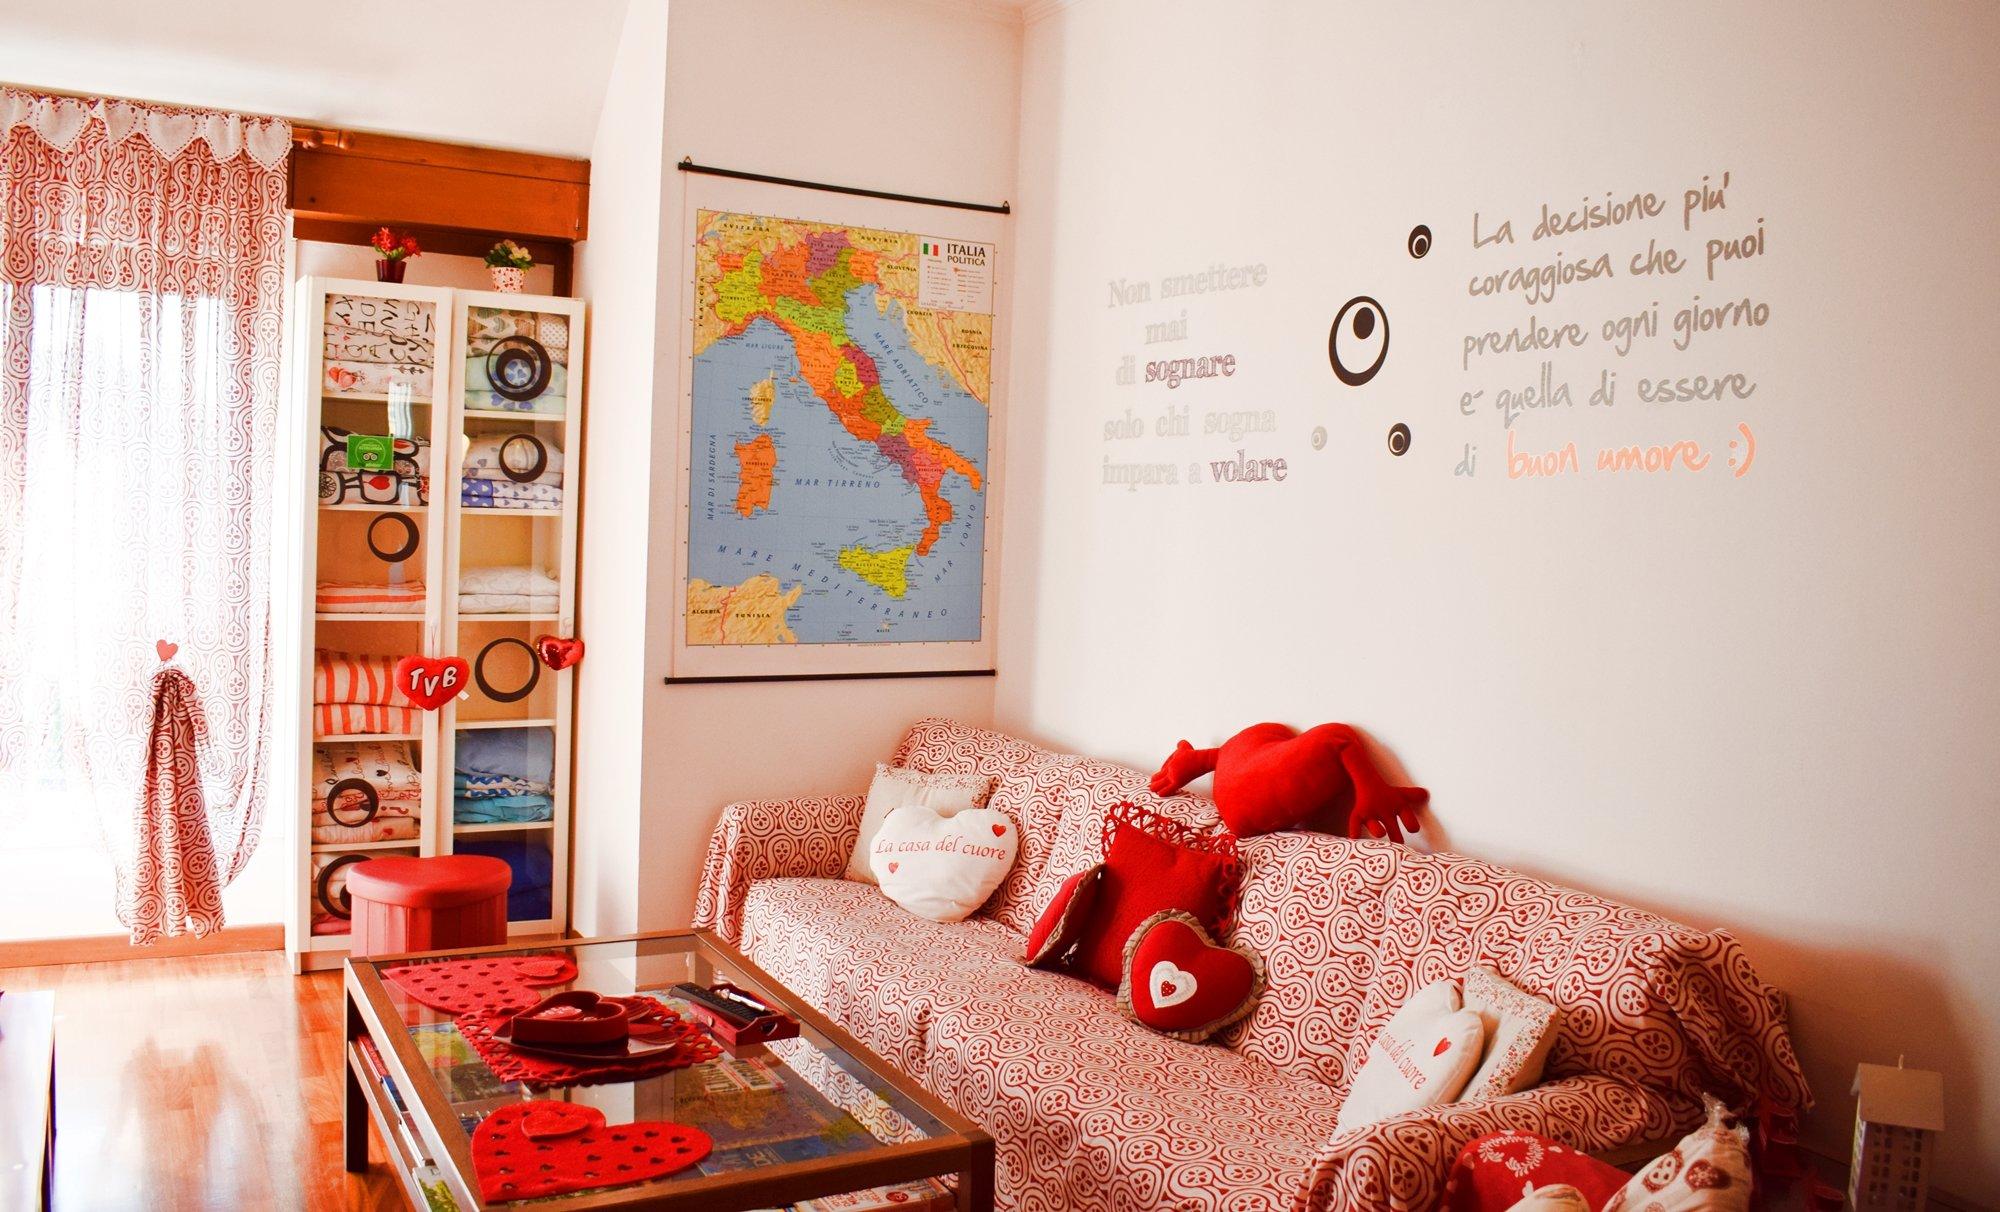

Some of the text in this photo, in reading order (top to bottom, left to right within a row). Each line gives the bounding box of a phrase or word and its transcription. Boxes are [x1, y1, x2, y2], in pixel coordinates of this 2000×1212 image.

[1473, 212, 1514, 249] La
[1532, 192, 1666, 241] decisione
[887, 264, 917, 272] SLOVENIA
[947, 243, 986, 258] ITALIA
[947, 255, 986, 267] POLITICA
[1469, 217, 1764, 305] coraggiosa che puoi
[1107, 262, 1268, 308] Non smettere
[1144, 309, 1188, 345] mai
[1463, 295, 1770, 371] prendere ogni giorno
[873, 331, 929, 404] MARE ADRIATICO
[1115, 353, 1236, 389] di sognare
[1496, 361, 1573, 429] quella
[1589, 369, 1616, 407] di
[1638, 373, 1757, 403] essere
[1103, 405, 1277, 442] solo chi sogna
[708, 434, 717, 483] SARDEGNA
[1102, 449, 1288, 492] impara a volare
[1454, 442, 1477, 478] di
[1507, 430, 1579, 479] buon
[1597, 440, 1711, 474] umore
[795, 479, 880, 488] MAR TIRRENO
[960, 504, 976, 547] IONIO
[718, 545, 947, 619] MARE MEDITERRANEO
[876, 834, 1006, 861] La casa del cuore
[1398, 1057, 1426, 1090] cuore
